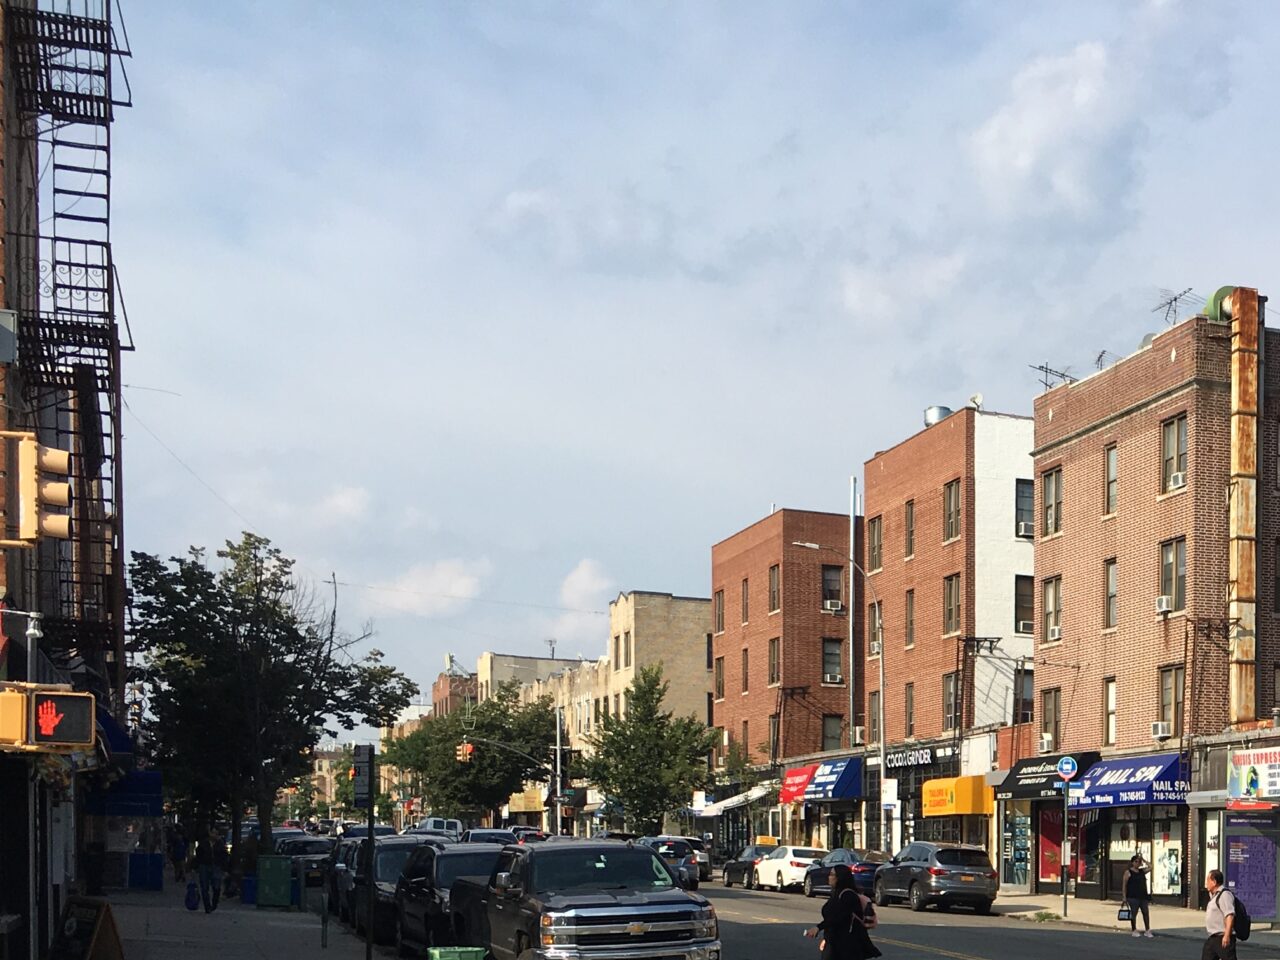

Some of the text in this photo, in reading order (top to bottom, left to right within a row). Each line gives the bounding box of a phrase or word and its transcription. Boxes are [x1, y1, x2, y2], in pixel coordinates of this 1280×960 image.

[886, 749, 932, 768] COCOA GRINDER
[1096, 765, 1163, 786] NAIL SPA
[1153, 780, 1191, 791] NAIL SPA
[1095, 793, 1114, 804] Waxing
[1153, 791, 1187, 801] 718-745-913
[1111, 840, 1136, 852] NAILS
